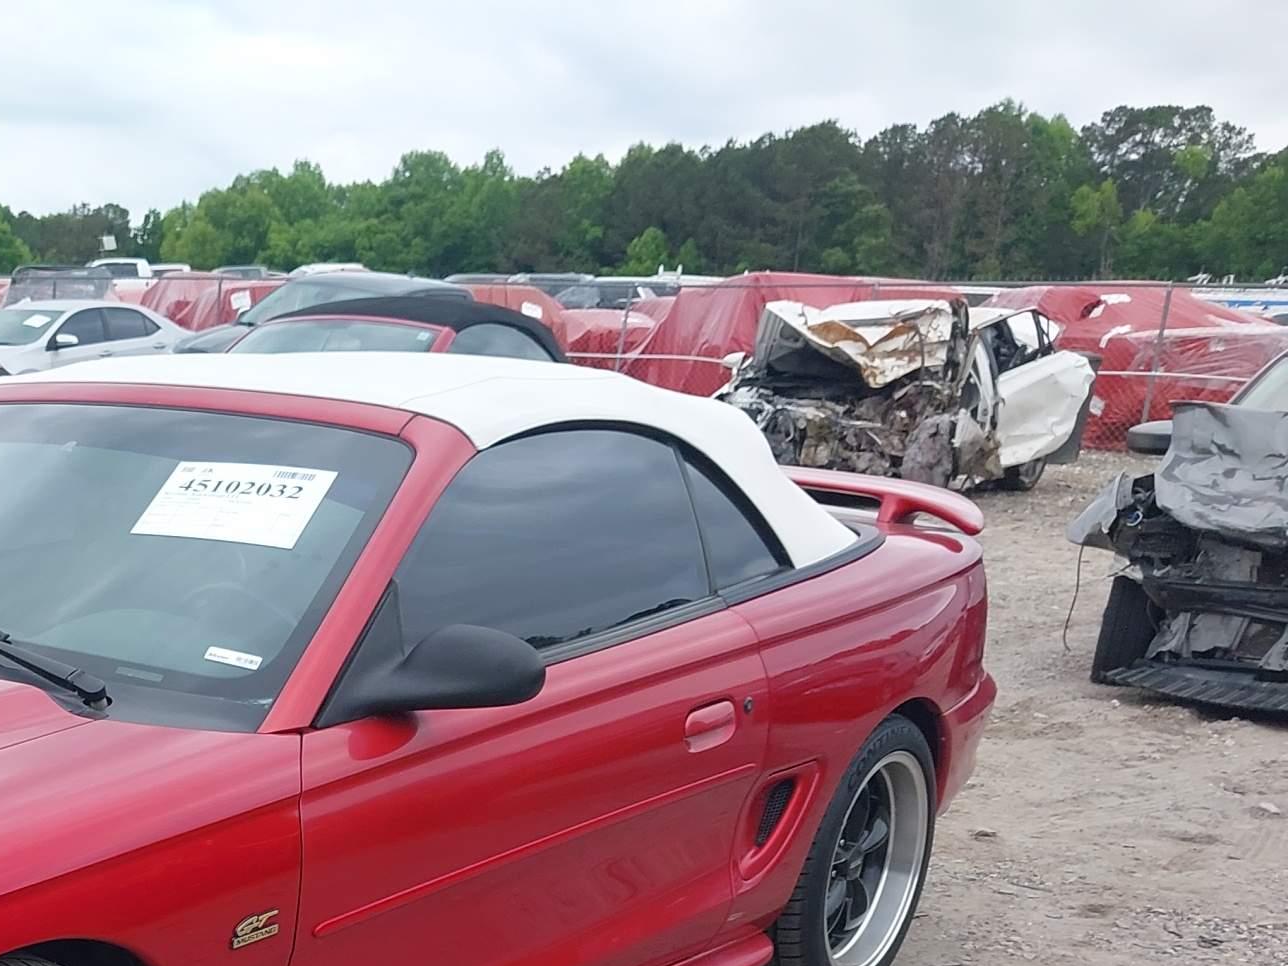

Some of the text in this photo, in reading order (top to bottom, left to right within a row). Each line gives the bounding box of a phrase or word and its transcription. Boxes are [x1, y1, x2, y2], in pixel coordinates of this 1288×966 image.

[179, 478, 303, 499] 45102032
[236, 909, 279, 937] GT
[234, 925, 278, 947] MUSTANG
